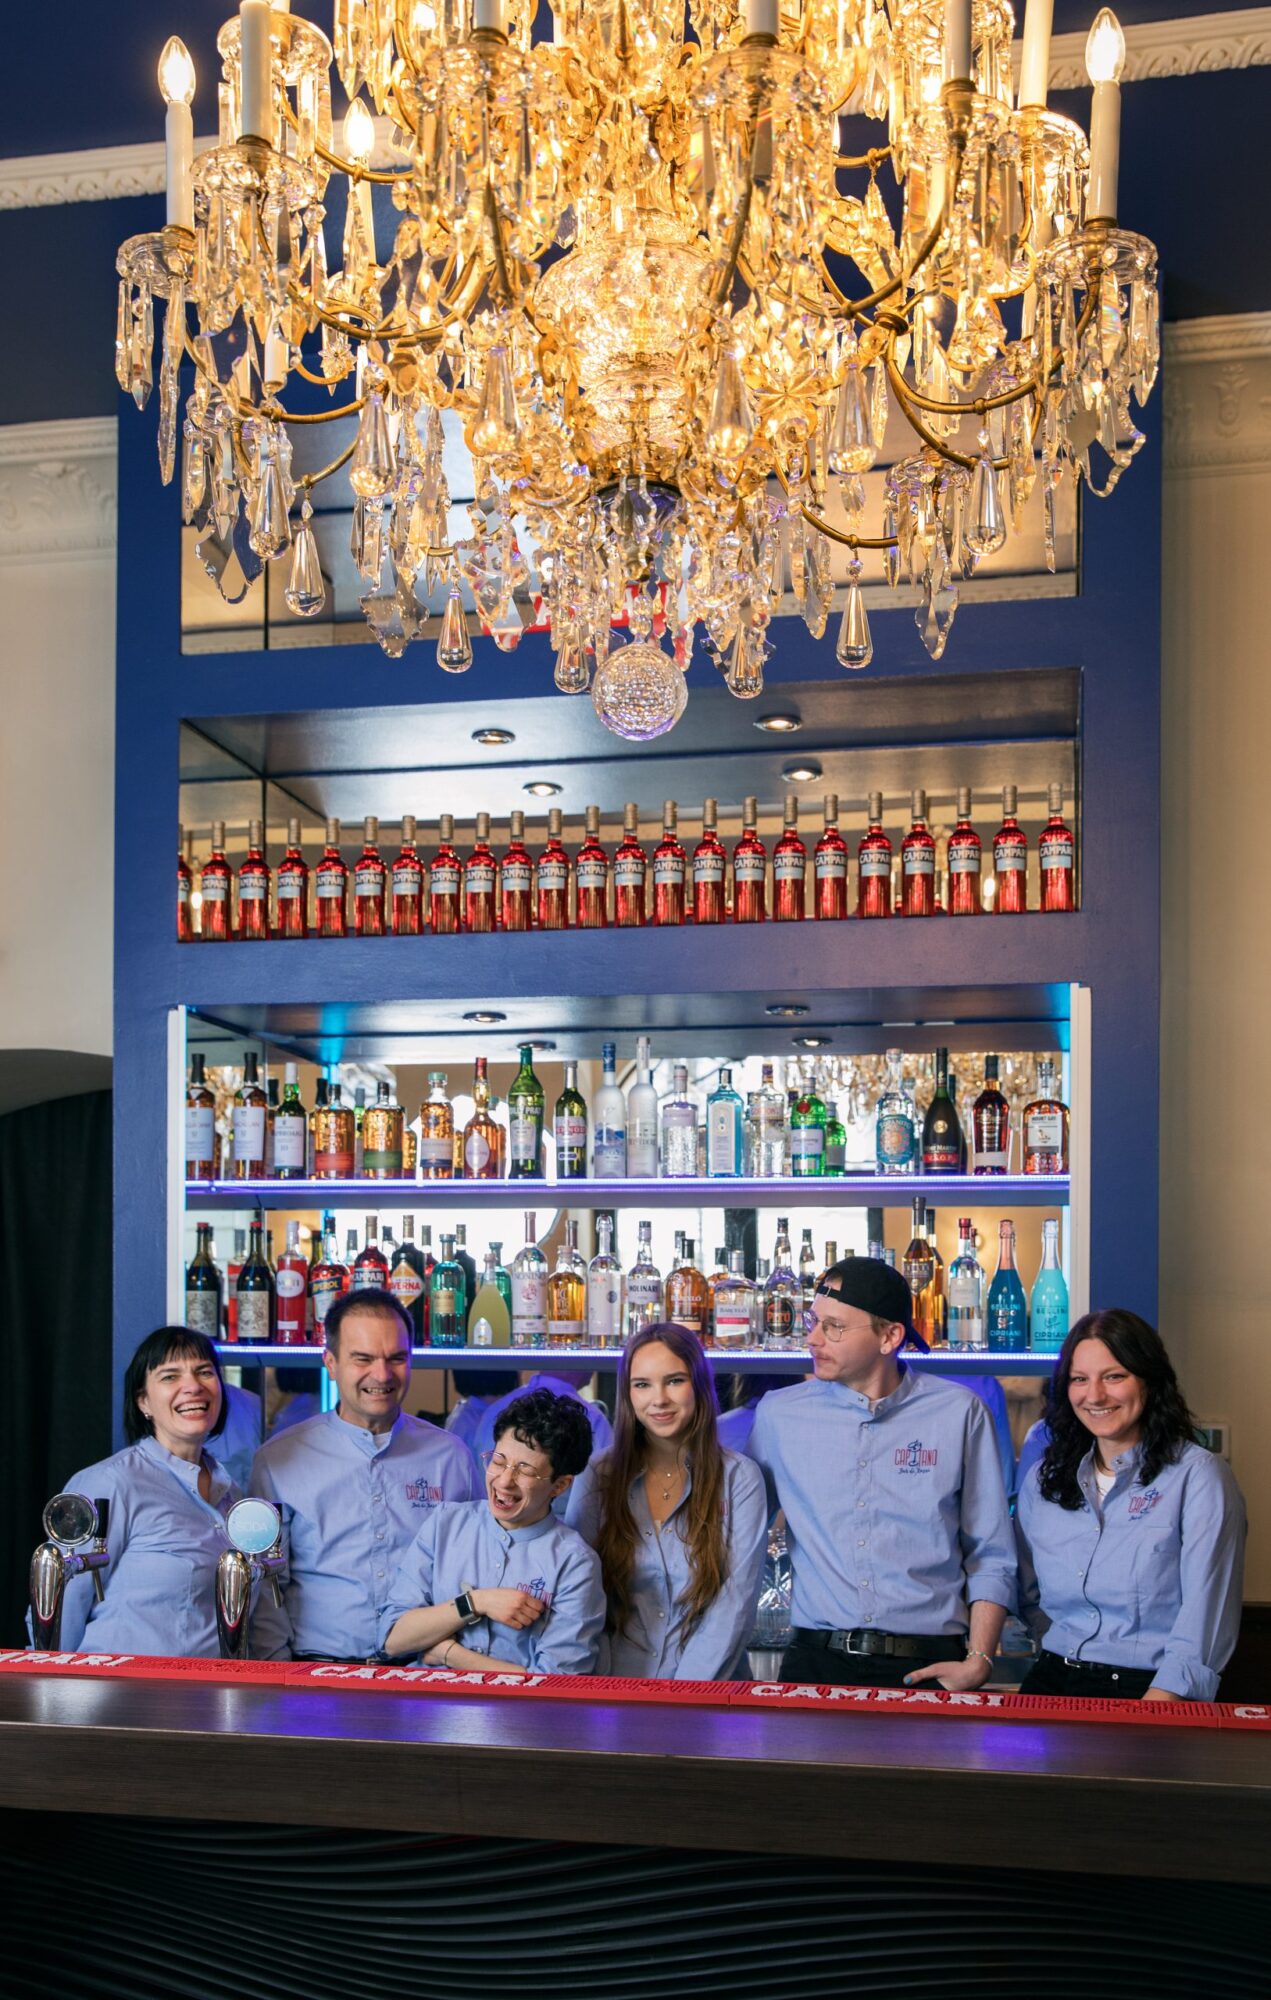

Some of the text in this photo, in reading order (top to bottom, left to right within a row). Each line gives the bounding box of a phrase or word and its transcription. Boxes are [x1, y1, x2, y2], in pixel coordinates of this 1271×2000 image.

[316, 875, 344, 887] AMPARI
[1034, 1330, 1068, 1338] CIPRIAN
[310, 1665, 548, 1688] CAMPARI
[751, 1684, 1006, 1708] CAMPARI
